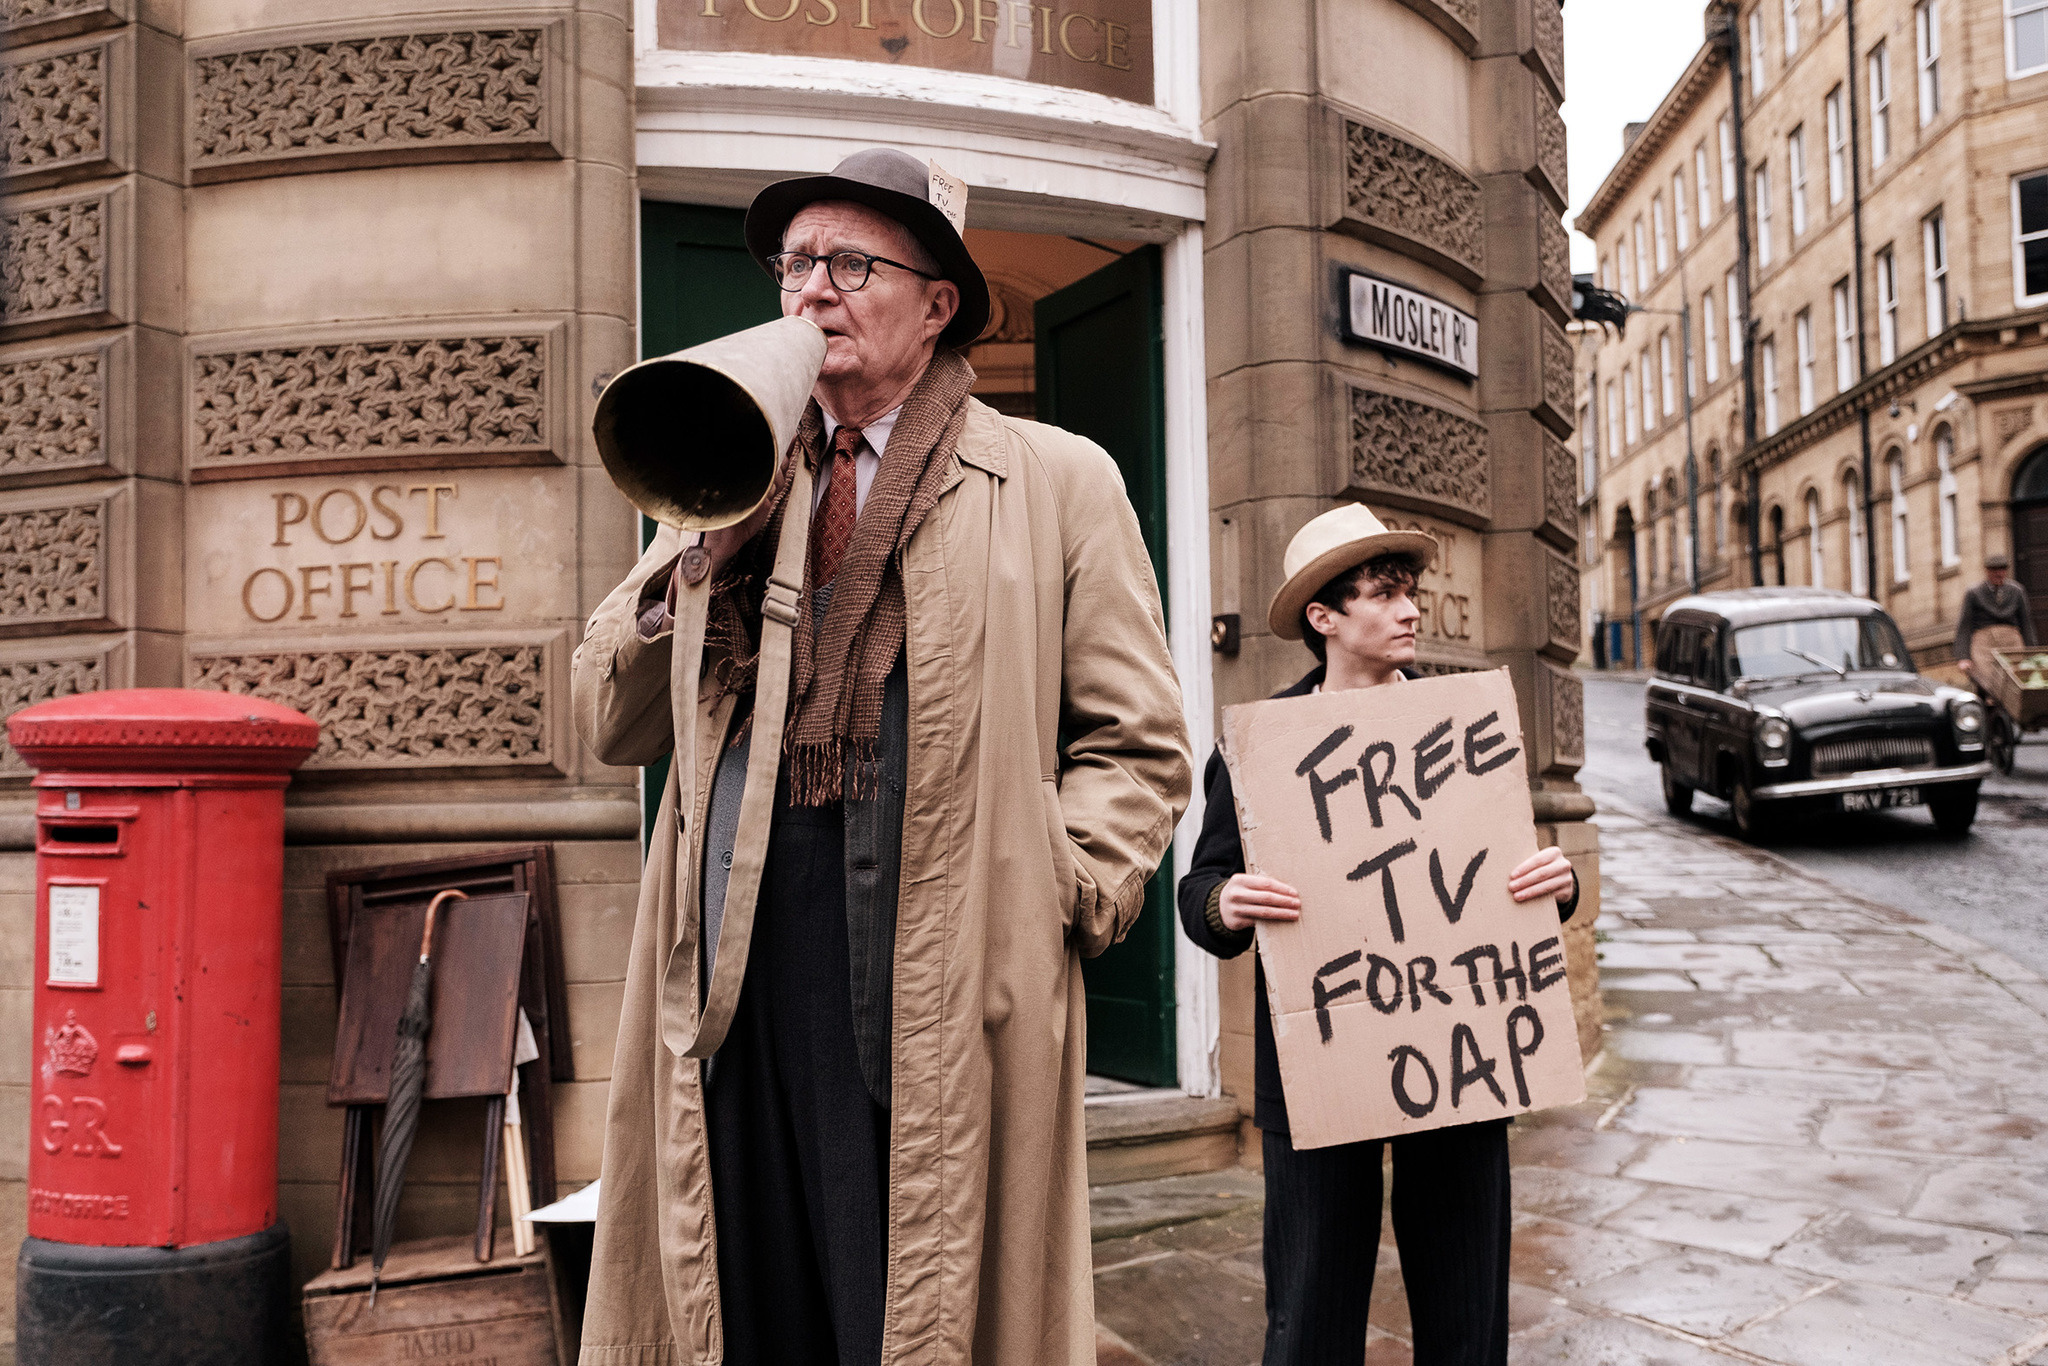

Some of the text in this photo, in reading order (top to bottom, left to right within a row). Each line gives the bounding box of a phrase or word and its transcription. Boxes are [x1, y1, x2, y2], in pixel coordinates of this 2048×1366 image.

[911, 0, 1132, 71] OFFICE
[932, 174, 954, 193] FREE
[936, 193, 949, 206] TV
[1371, 284, 1447, 356] MOSLEY
[271, 483, 459, 547] POST
[242, 556, 505, 624] OFFICE
[1296, 711, 1520, 843] FREE
[1346, 838, 1488, 943] TV
[1312, 937, 1567, 1045] FOR THE
[1387, 1004, 1544, 1118] OAP
